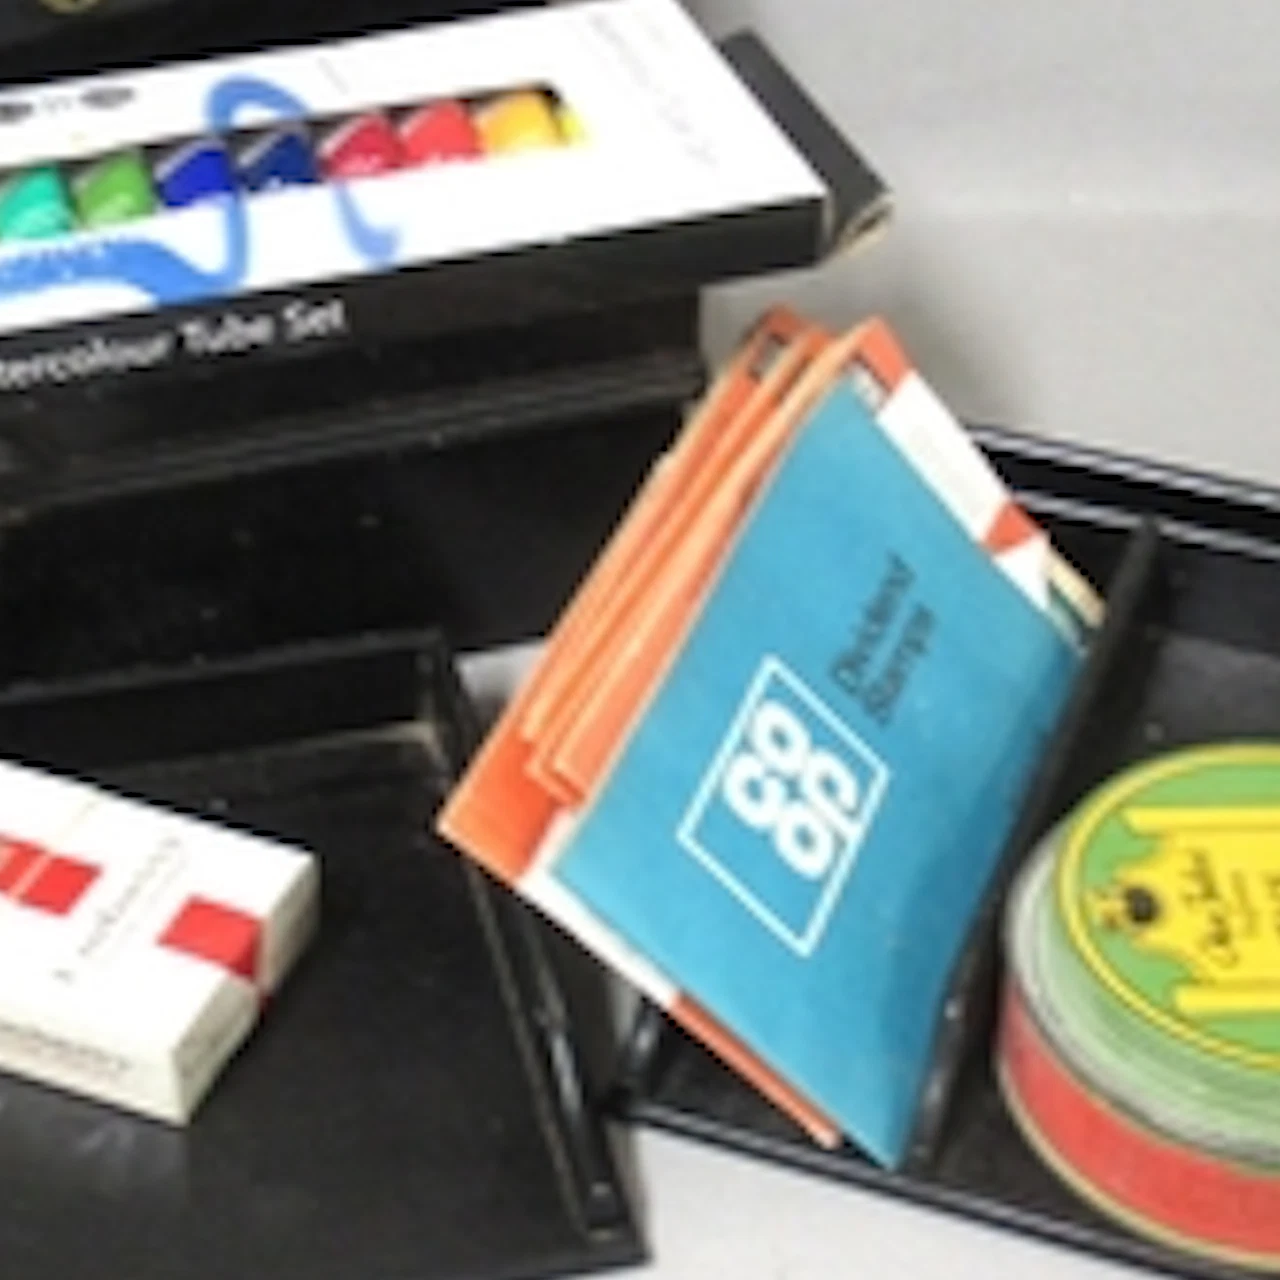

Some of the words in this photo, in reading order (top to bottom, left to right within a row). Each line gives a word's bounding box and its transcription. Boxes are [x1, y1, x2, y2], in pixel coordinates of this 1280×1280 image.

[178, 310, 276, 365] Tube
[282, 297, 348, 340] Set
[830, 551, 916, 699] Dividend
[863, 600, 938, 728] Stamps
